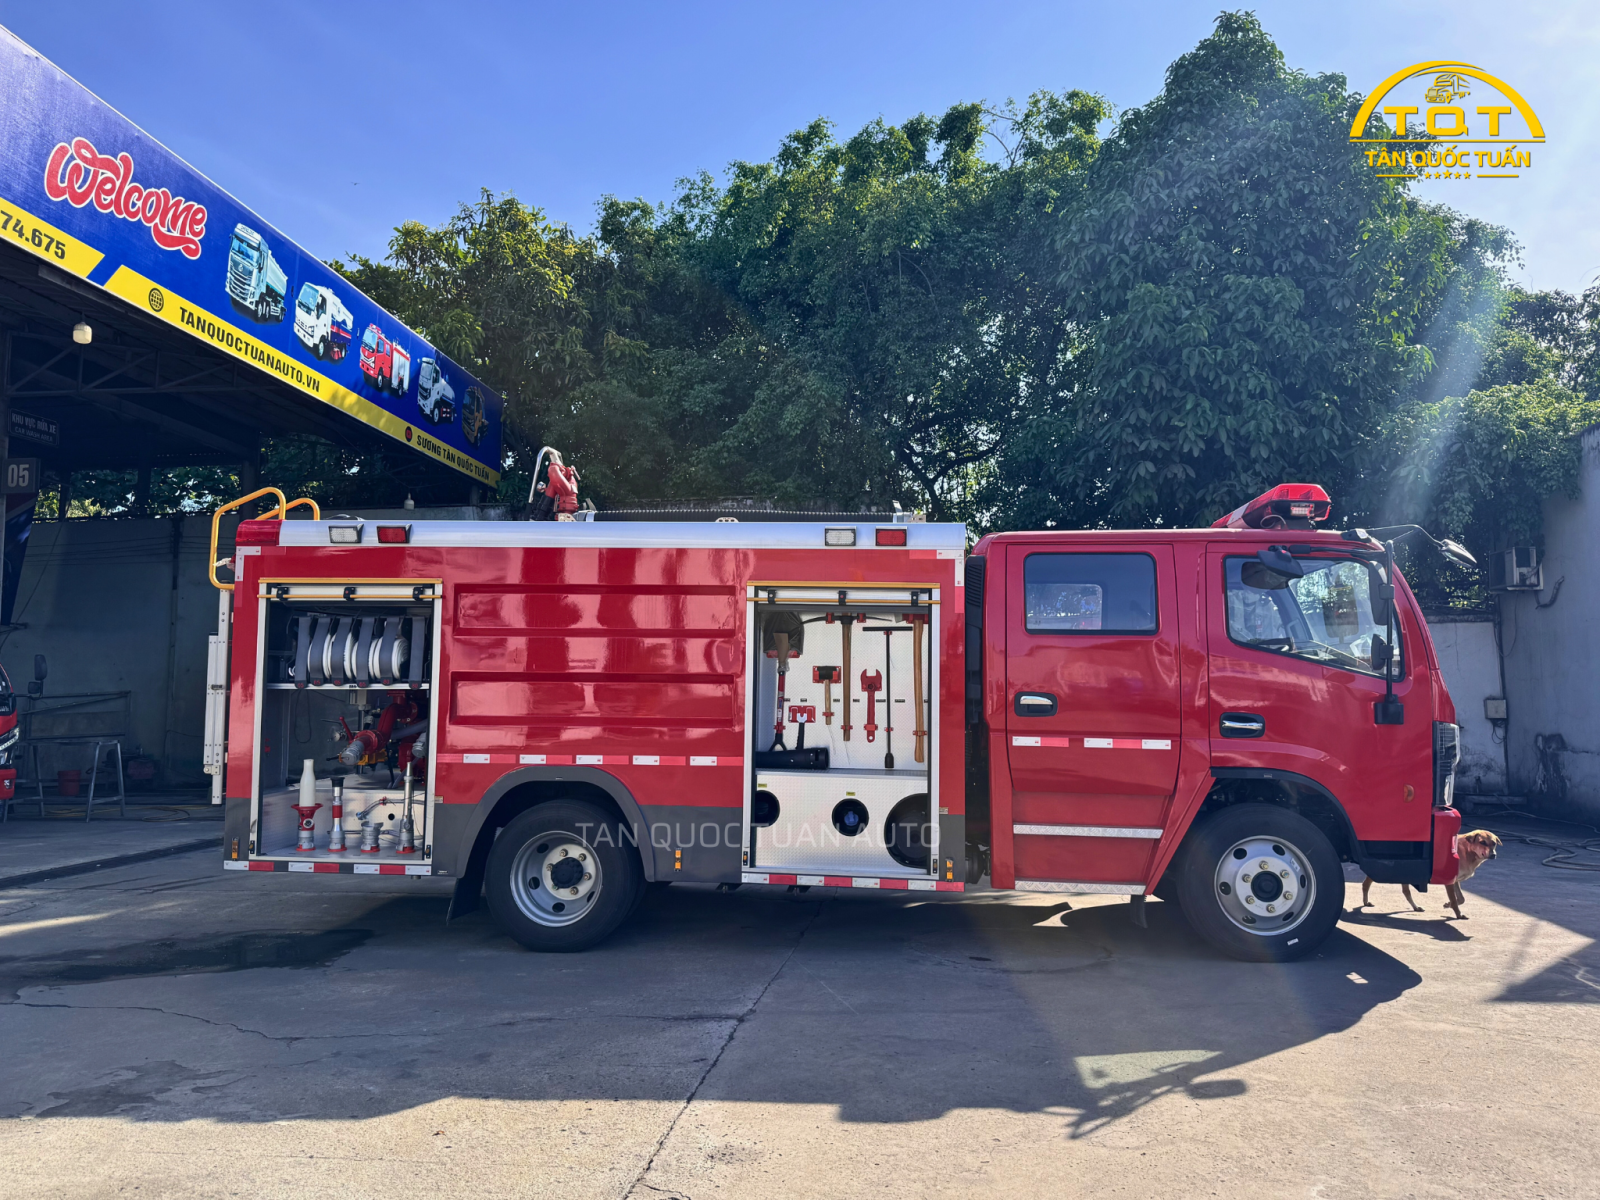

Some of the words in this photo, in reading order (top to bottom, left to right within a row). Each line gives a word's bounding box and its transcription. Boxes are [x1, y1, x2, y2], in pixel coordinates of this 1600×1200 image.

[44, 137, 207, 260] Welcome
[0, 209, 66, 260] 74.675
[179, 306, 320, 393] TANQUOCTUANAUTO.VN
[11, 412, 24, 425] KHU
[14, 426, 25, 435] CAR
[8, 464, 29, 487] 05
